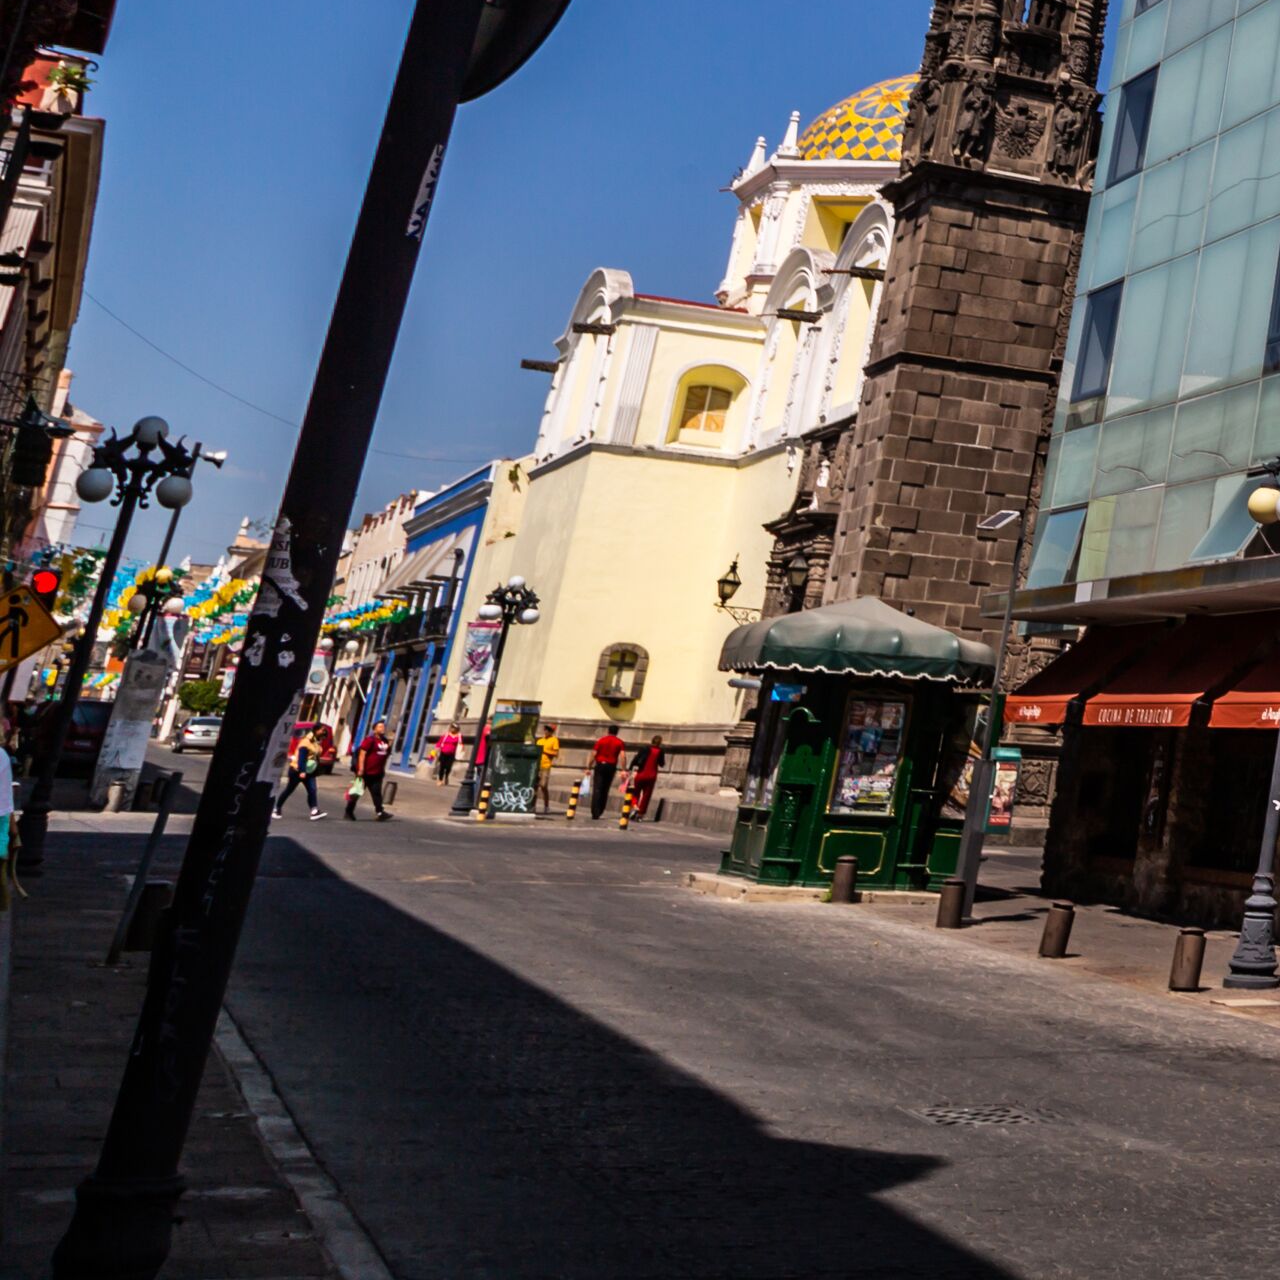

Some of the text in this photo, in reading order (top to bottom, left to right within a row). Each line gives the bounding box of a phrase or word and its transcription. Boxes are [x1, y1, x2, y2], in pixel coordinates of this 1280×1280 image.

[1098, 706, 1173, 724] COCINA DE TRADICIÓN
